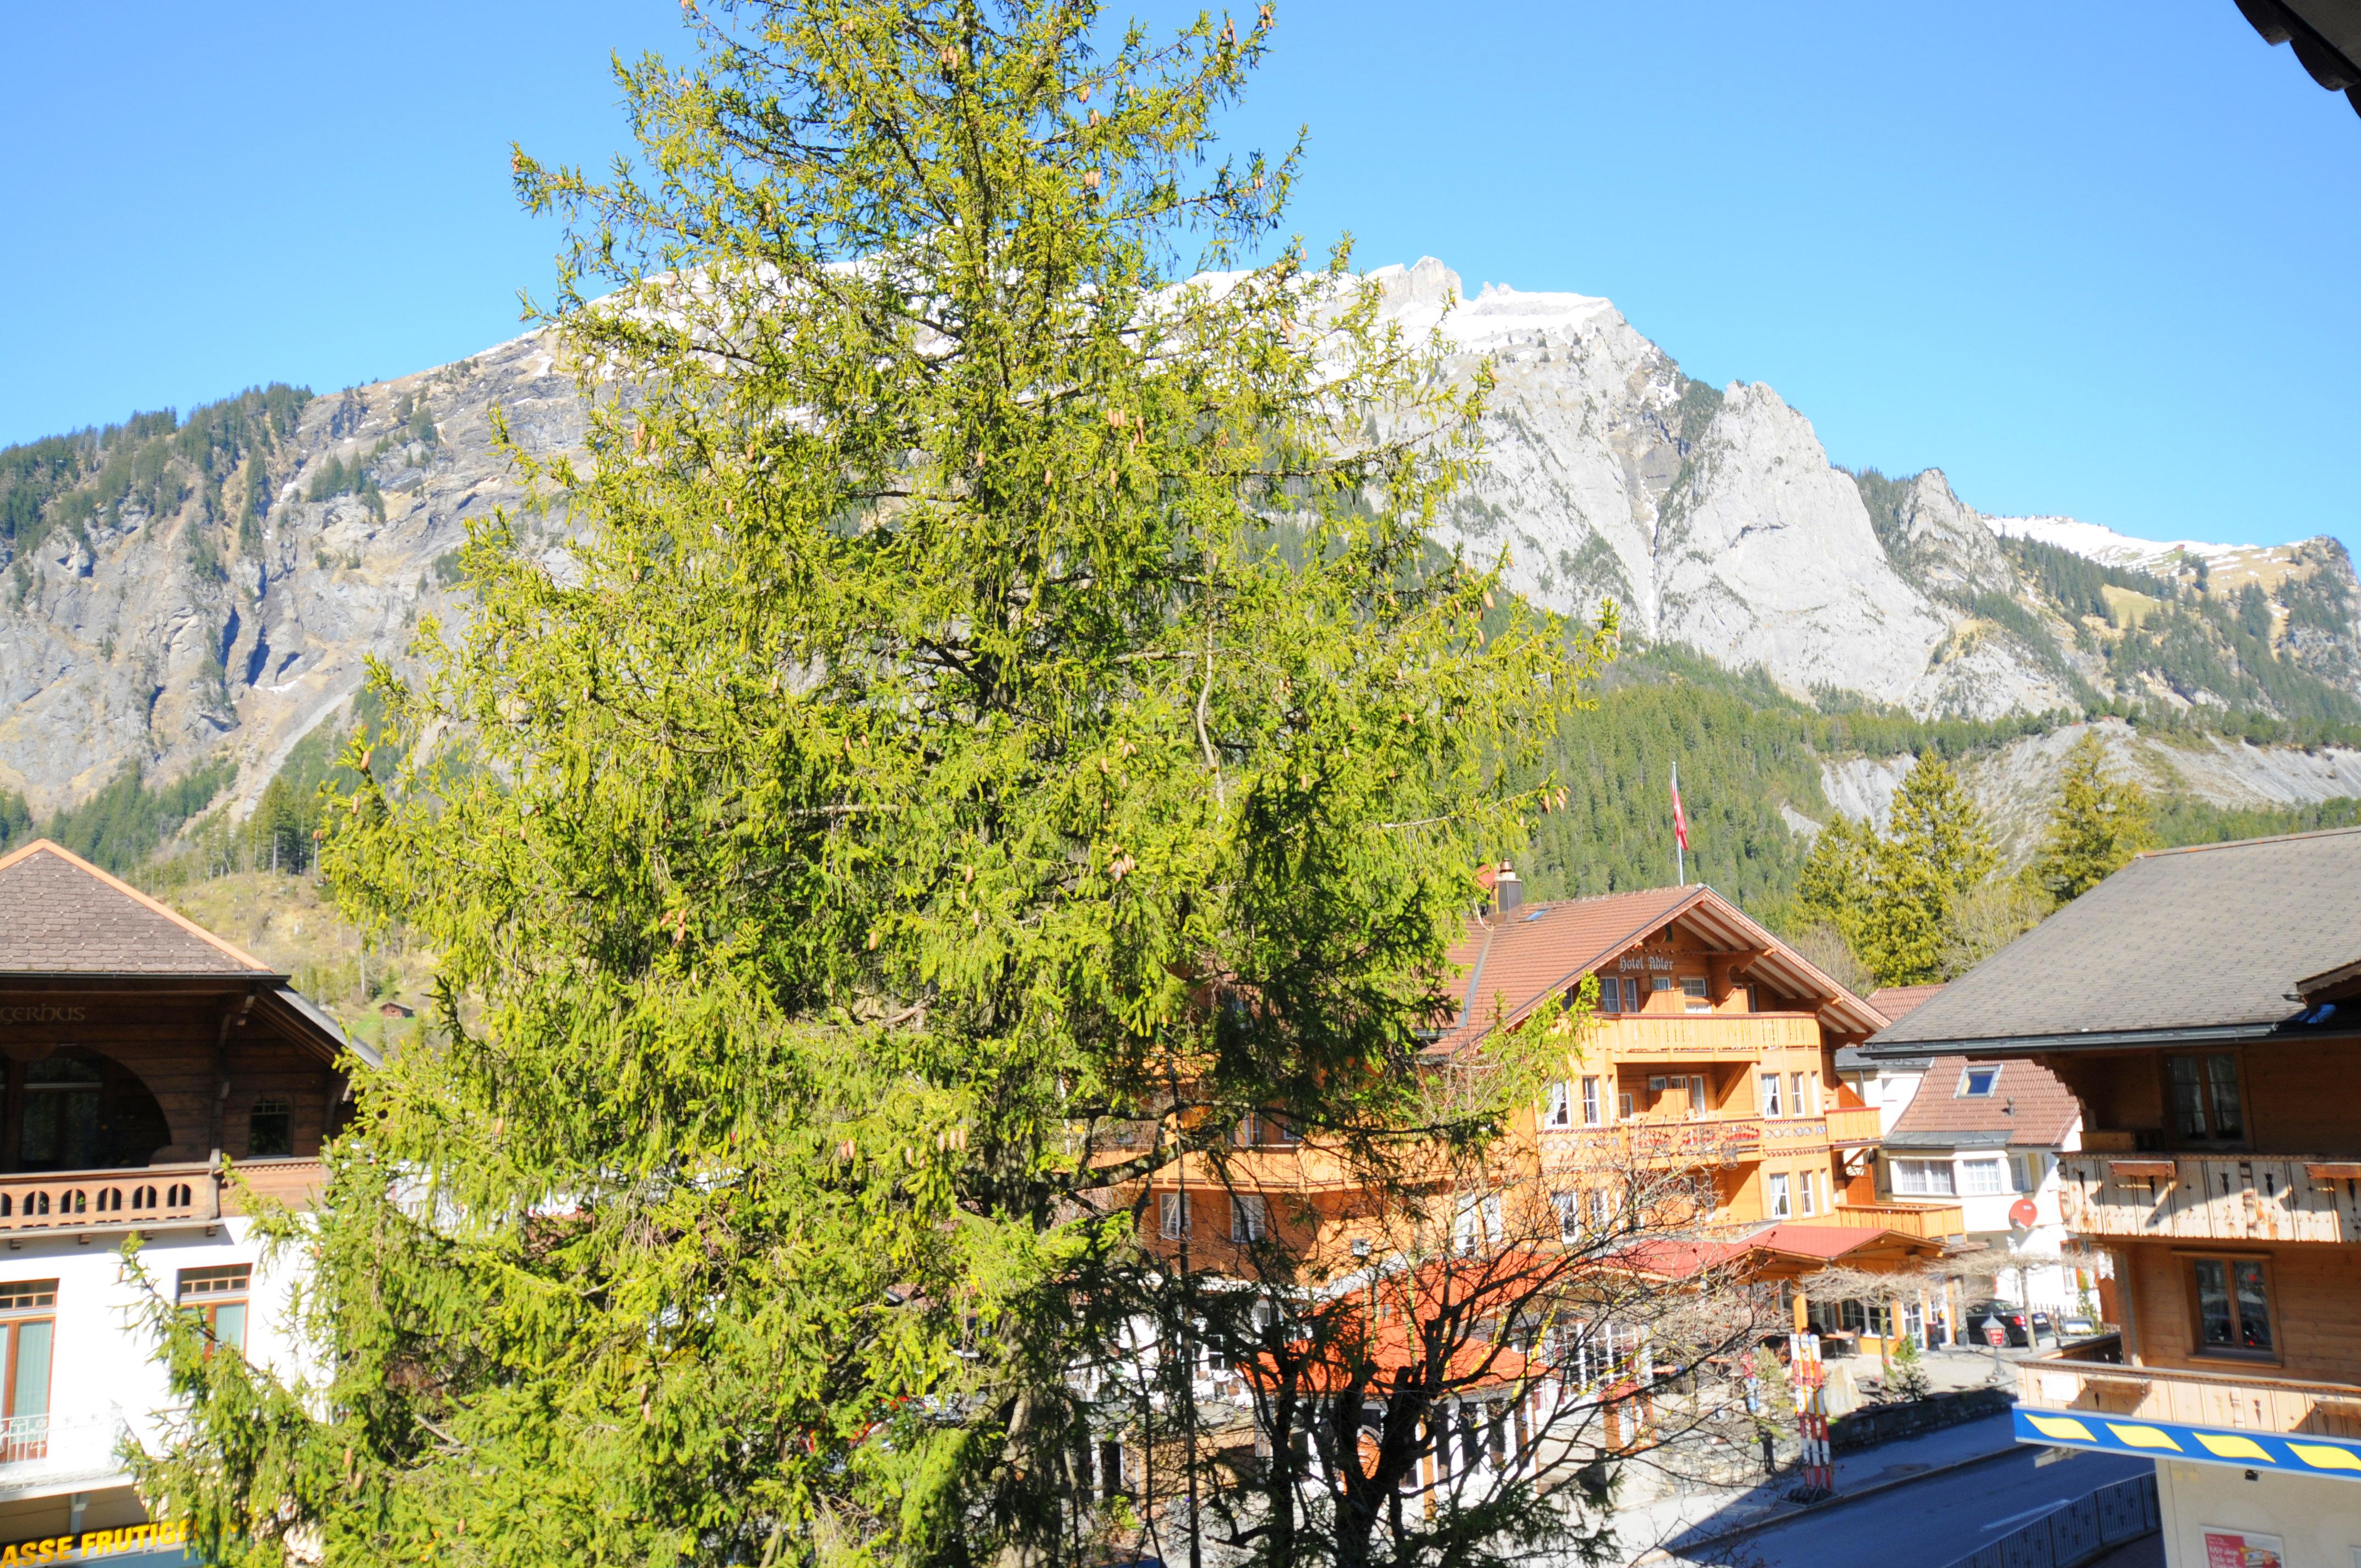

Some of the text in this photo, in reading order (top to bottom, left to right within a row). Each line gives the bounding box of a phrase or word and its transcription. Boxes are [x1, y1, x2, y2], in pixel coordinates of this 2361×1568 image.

[1620, 955, 1674, 972] Hotel Adler
[0, 1535, 74, 1568] ASSE
[2209, 1546, 2222, 1554] Mit
